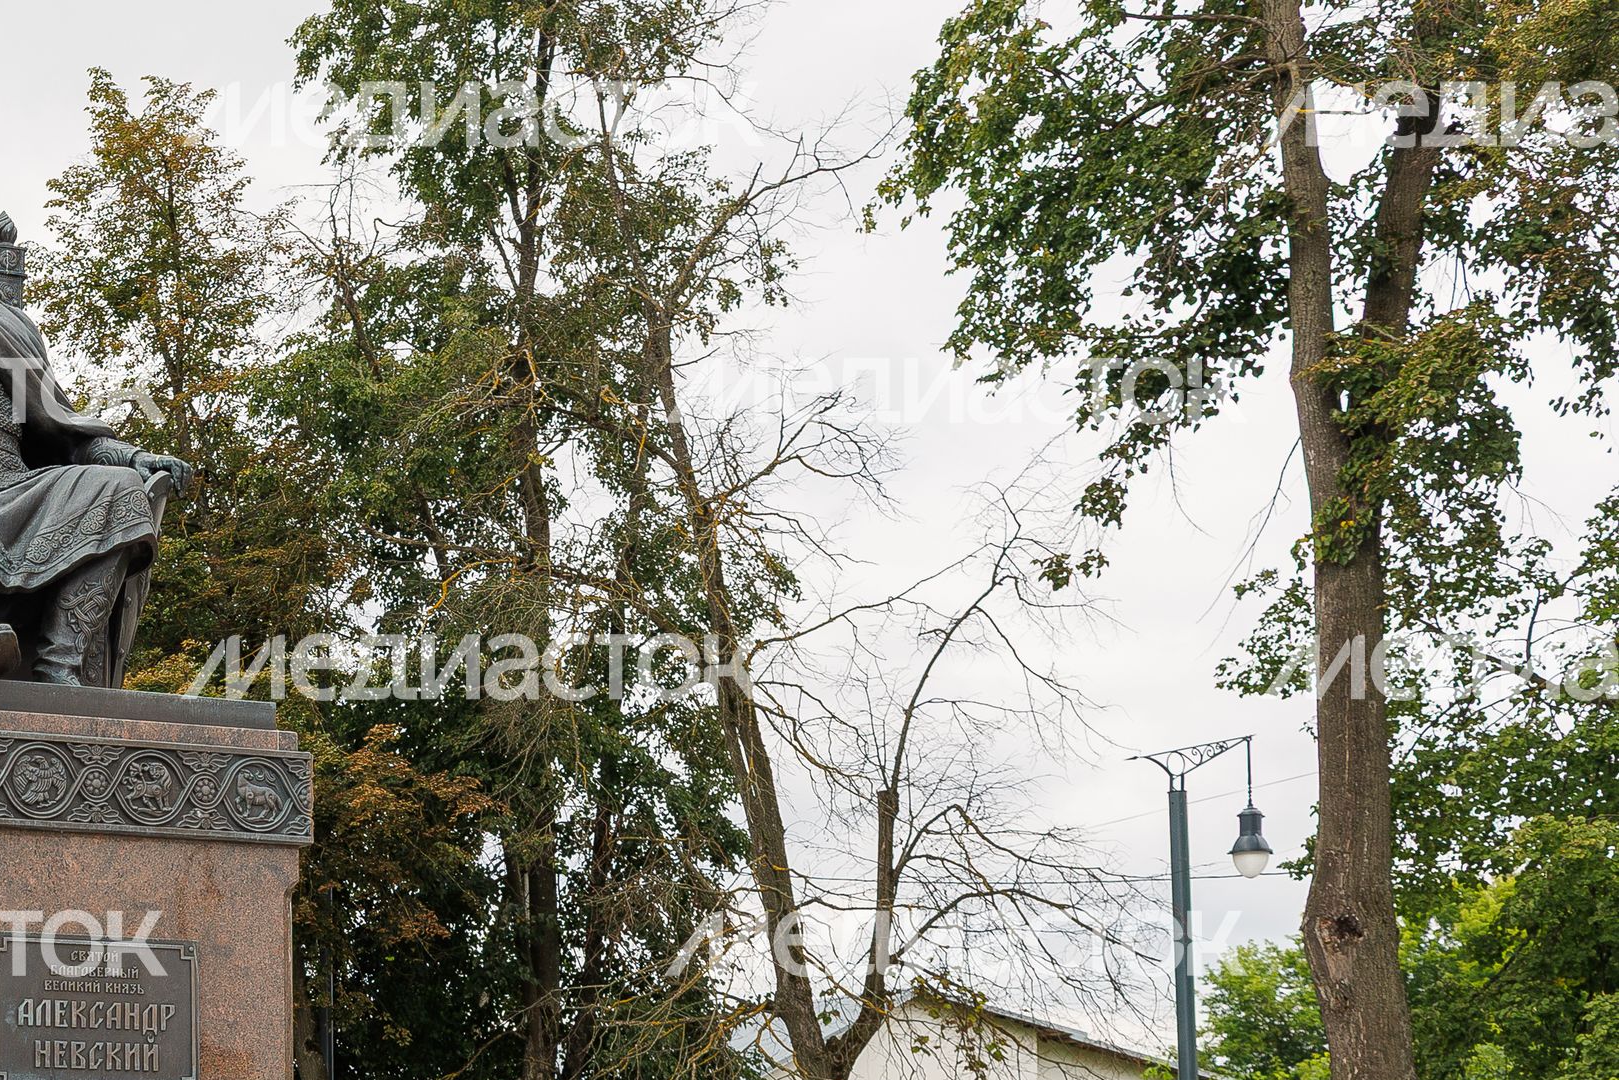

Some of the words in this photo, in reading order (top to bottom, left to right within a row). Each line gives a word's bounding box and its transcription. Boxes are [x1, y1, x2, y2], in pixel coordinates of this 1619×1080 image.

[70, 950, 119, 963] СВЯТОЙ
[50, 964, 139, 979] БЛАГОВЕРНЫЙ
[44, 979, 101, 993] ВЕЛИКИЙ
[105, 982, 146, 995] КНЯЗЬ
[17, 998, 176, 1035] АЛЕКСАНДР
[34, 1031, 160, 1072] НЕВСКИЙ
